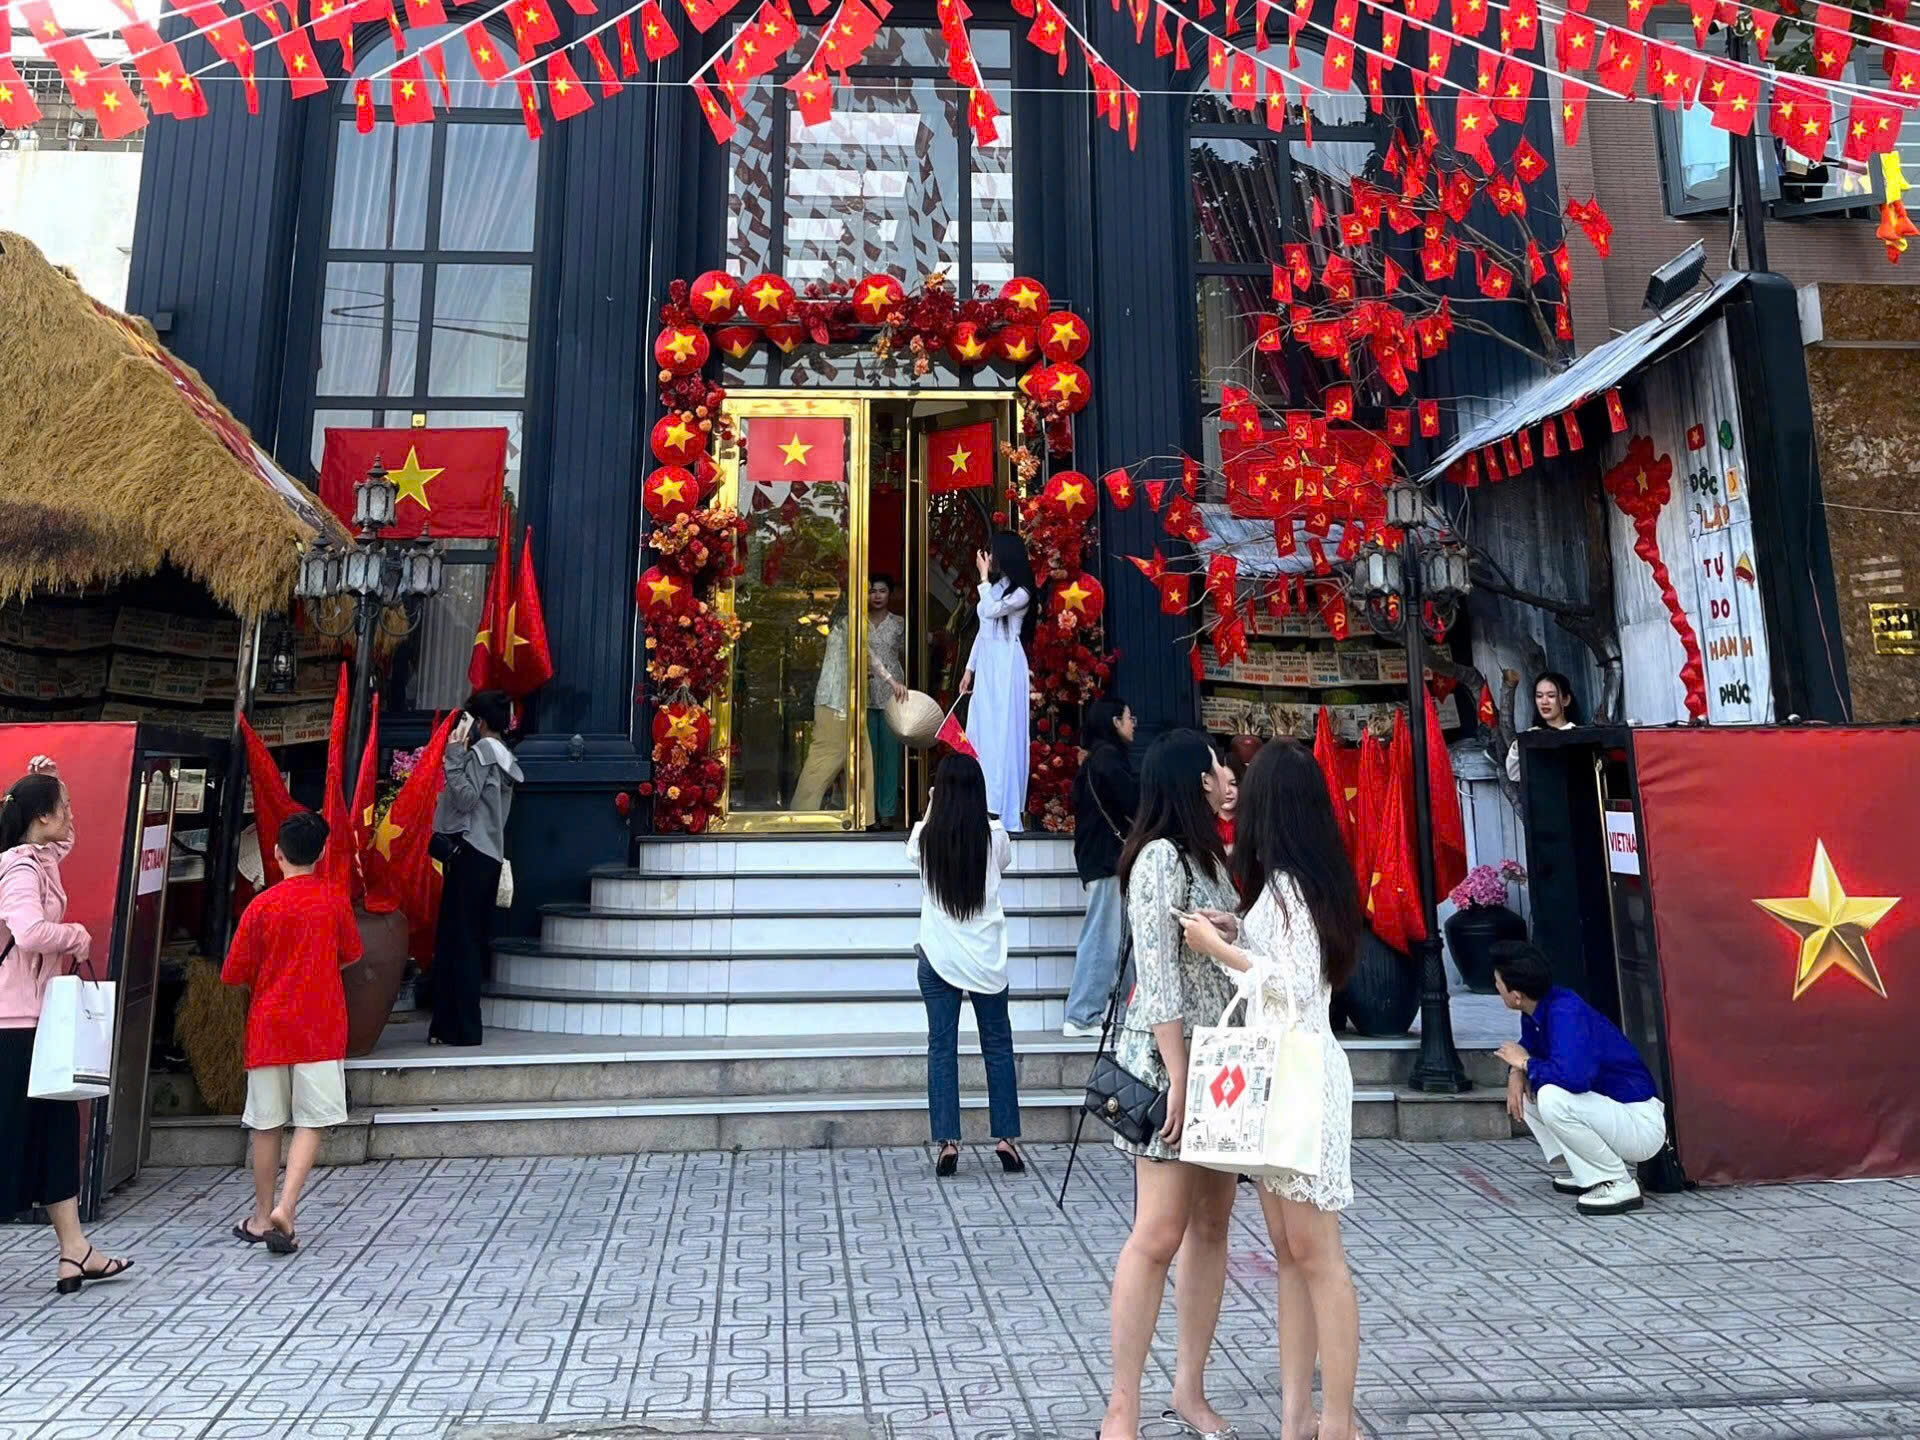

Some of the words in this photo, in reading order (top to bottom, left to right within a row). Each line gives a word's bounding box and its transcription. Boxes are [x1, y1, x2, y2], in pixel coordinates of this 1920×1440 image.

[1690, 466, 1719, 496] ĐỘC
[1710, 598, 1731, 620] DO
[1719, 679, 1752, 707] PHÚC
